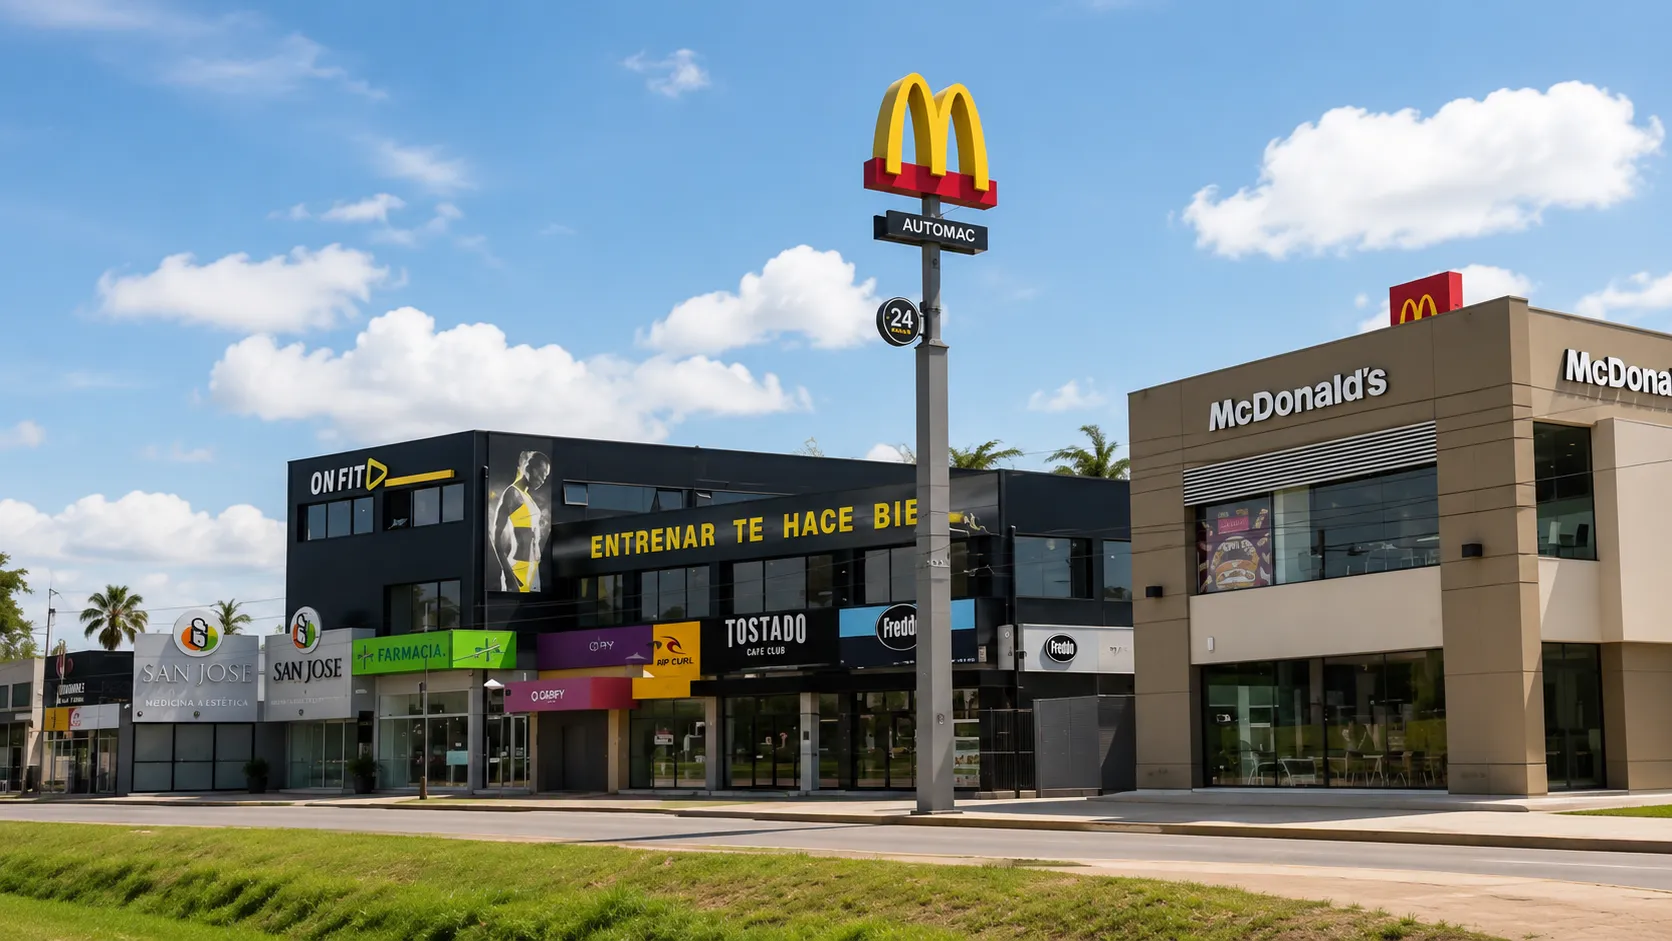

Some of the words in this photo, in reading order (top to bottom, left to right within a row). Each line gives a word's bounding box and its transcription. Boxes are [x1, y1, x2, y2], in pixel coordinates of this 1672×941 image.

[902, 218, 975, 242] AUTOMAC
[890, 307, 914, 329] 24
[1566, 348, 1672, 396] McDona
[1209, 367, 1387, 432] McDonald's
[591, 522, 715, 558] ENTRENAR
[733, 516, 763, 543] TE
[783, 506, 853, 538] HACE
[874, 498, 918, 530] BIE
[725, 613, 807, 648] TOSTADO
[884, 614, 918, 639] Fredd
[671, 656, 694, 666] CURL
[767, 646, 786, 655] CLUB
[142, 663, 191, 683] SAN
[196, 663, 253, 687] JOSE
[273, 661, 303, 682] SAN
[304, 658, 342, 684] JOSE
